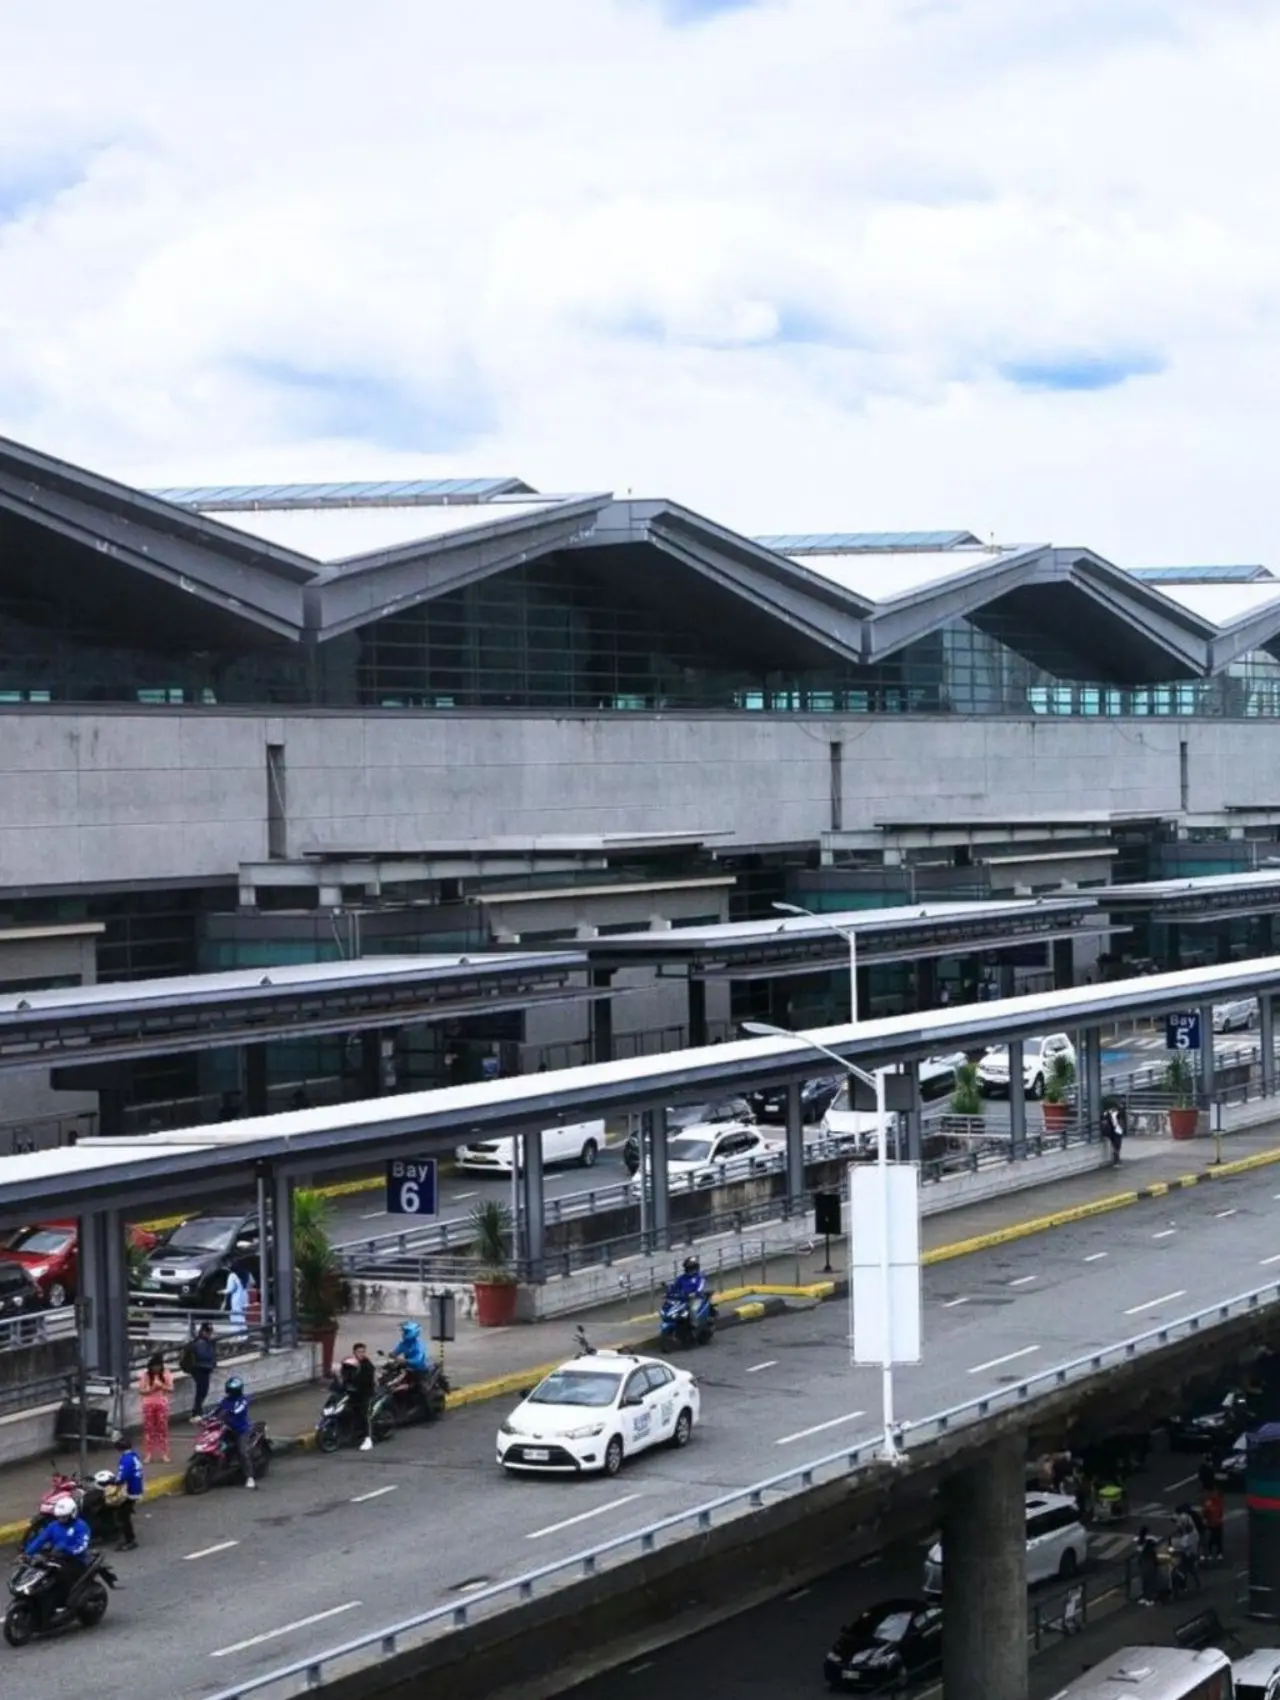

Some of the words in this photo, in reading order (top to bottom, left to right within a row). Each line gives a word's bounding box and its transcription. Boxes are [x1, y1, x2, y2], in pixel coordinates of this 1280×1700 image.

[1170, 1014, 1196, 1029] Bay
[1176, 1028, 1190, 1049] 5
[392, 1161, 428, 1183] Bay
[400, 1181, 420, 1213] 6
